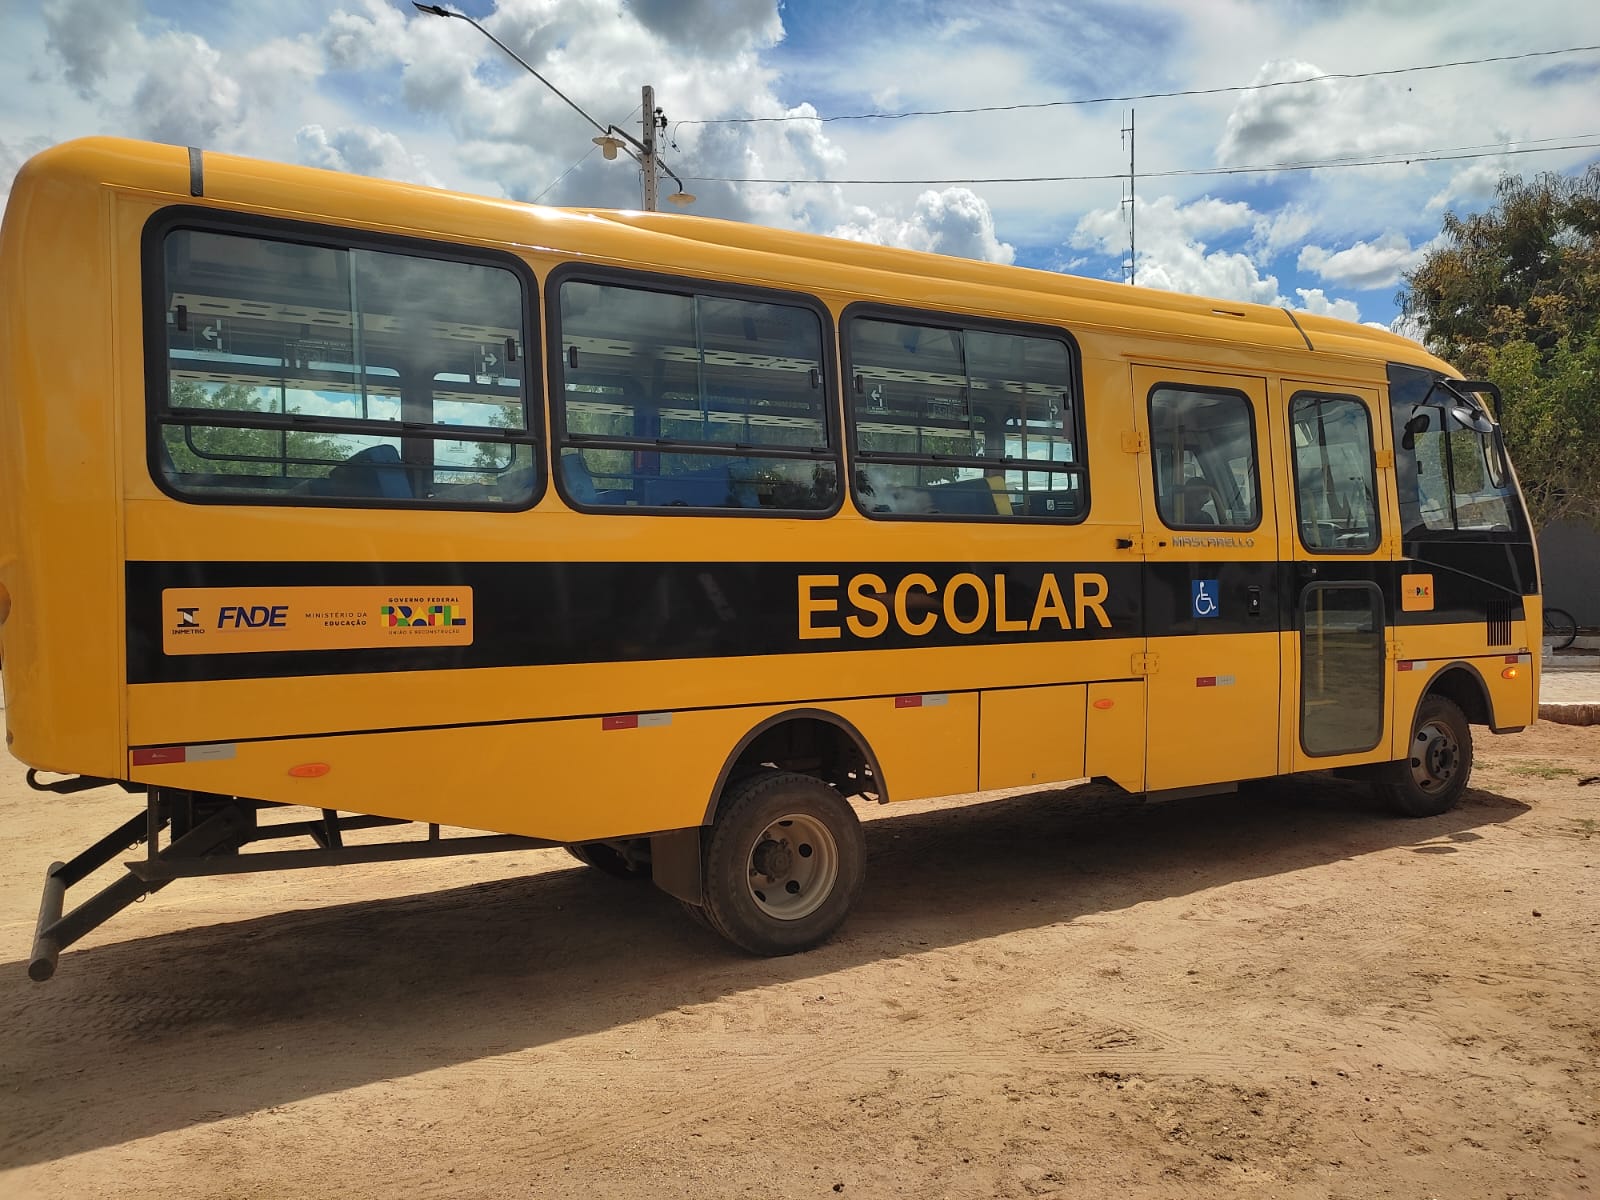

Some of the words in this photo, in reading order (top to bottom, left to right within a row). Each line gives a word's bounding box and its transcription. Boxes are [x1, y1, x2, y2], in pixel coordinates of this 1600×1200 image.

[1172, 535, 1255, 547] MASCARELLO
[217, 605, 289, 628] FNDE
[381, 605, 466, 627] BRASIL
[797, 572, 1113, 640] ESCOLAR
[324, 619, 367, 627] EDUCAÇÃO
